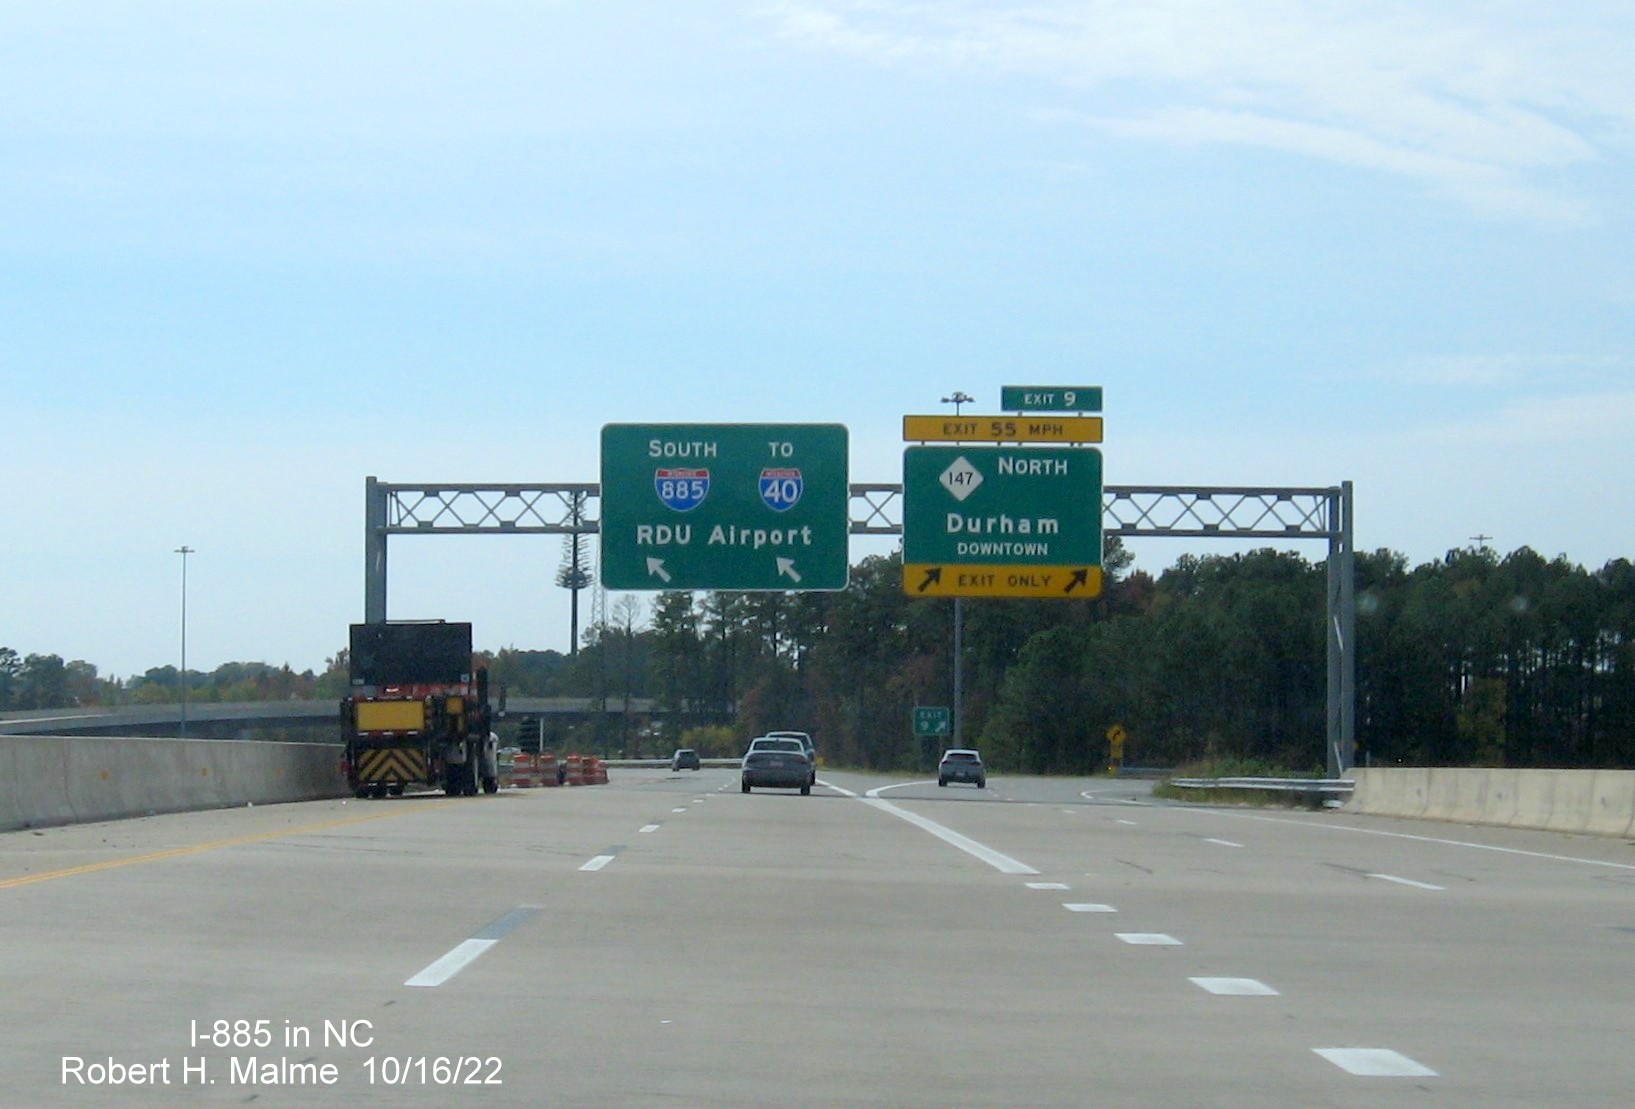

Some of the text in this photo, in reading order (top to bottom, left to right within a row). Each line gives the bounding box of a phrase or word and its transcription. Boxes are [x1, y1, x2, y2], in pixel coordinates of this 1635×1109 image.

[1024, 391, 1076, 406] EXIT 9
[943, 422, 1063, 437] EXIT 55 MPH
[649, 439, 717, 458] SOUTH
[768, 442, 793, 458] TO
[999, 457, 1068, 475] NORTH
[949, 471, 973, 486] 147
[662, 480, 704, 500] 885
[764, 479, 798, 503] 40
[947, 513, 1059, 534] Durham
[636, 525, 812, 549] RDU Airport
[957, 542, 1048, 556] DOWNTOWN
[958, 574, 1051, 588] EXIT ONLY
